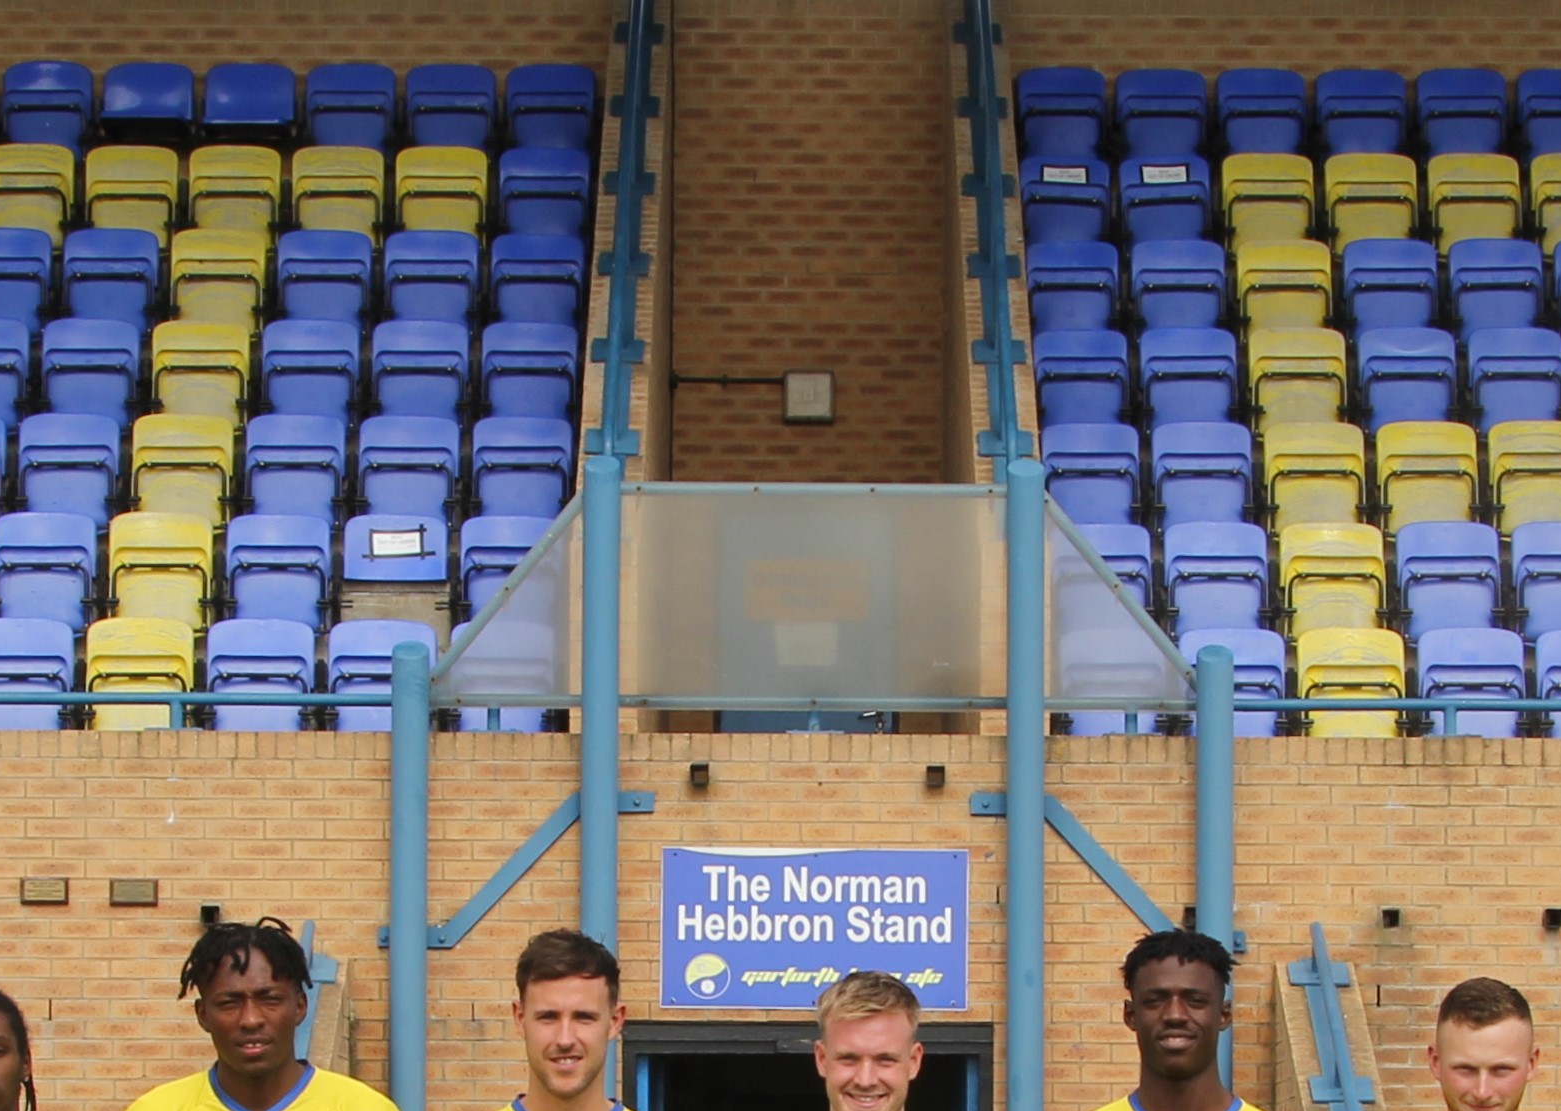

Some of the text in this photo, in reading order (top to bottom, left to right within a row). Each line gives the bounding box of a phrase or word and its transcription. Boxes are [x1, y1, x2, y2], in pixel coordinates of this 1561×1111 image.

[702, 865, 927, 904] The Norman
[677, 904, 953, 943] Hebbron Stand
